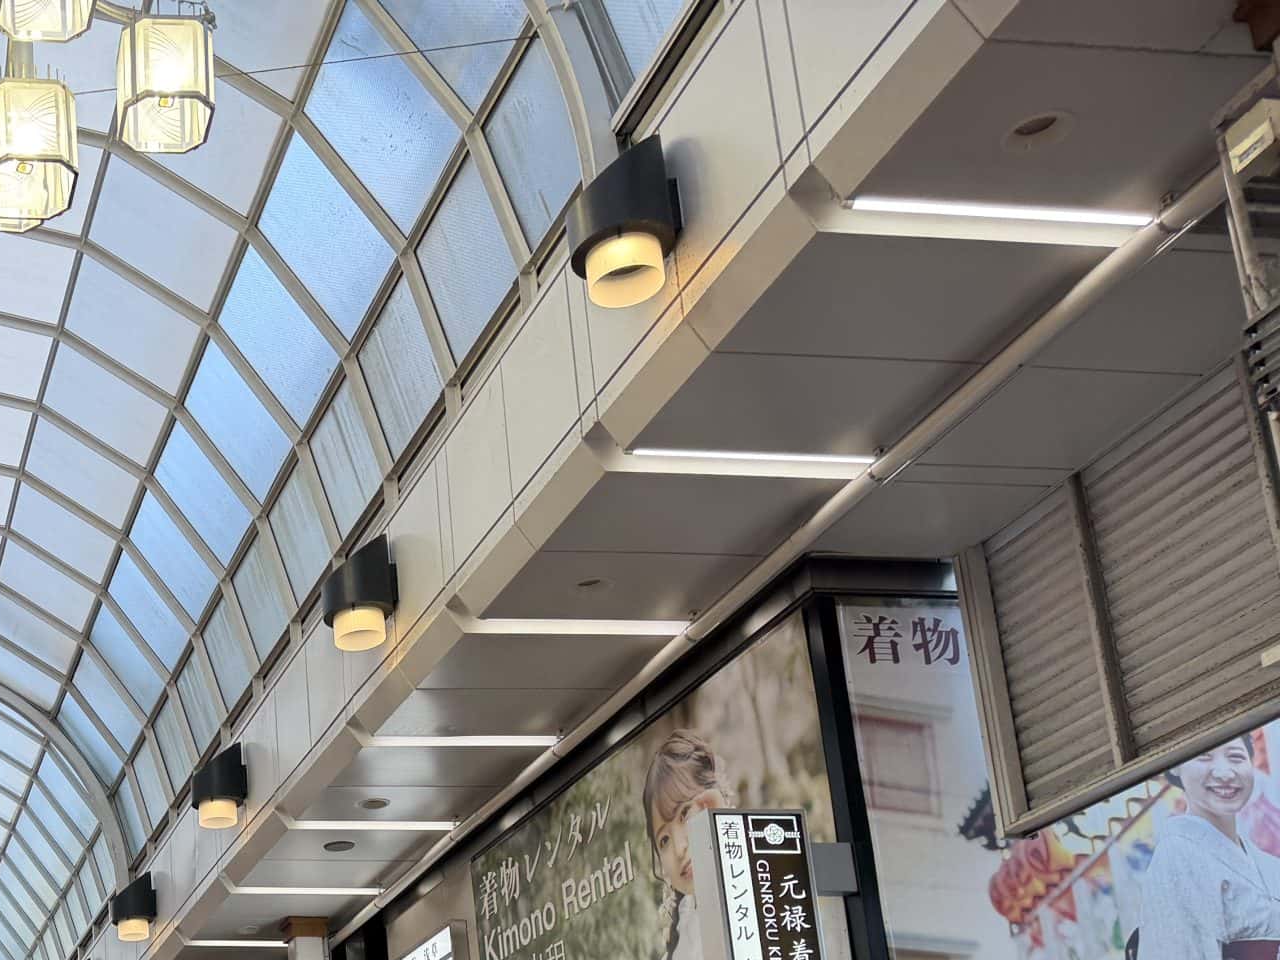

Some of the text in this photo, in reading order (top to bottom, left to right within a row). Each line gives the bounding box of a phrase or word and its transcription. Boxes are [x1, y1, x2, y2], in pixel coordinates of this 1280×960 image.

[852, 615, 960, 666] 着物
[478, 793, 613, 921] 着物レンタル
[562, 843, 634, 914] Rental
[721, 821, 754, 941] 着物レンタル
[756, 859, 779, 940] GENROKU
